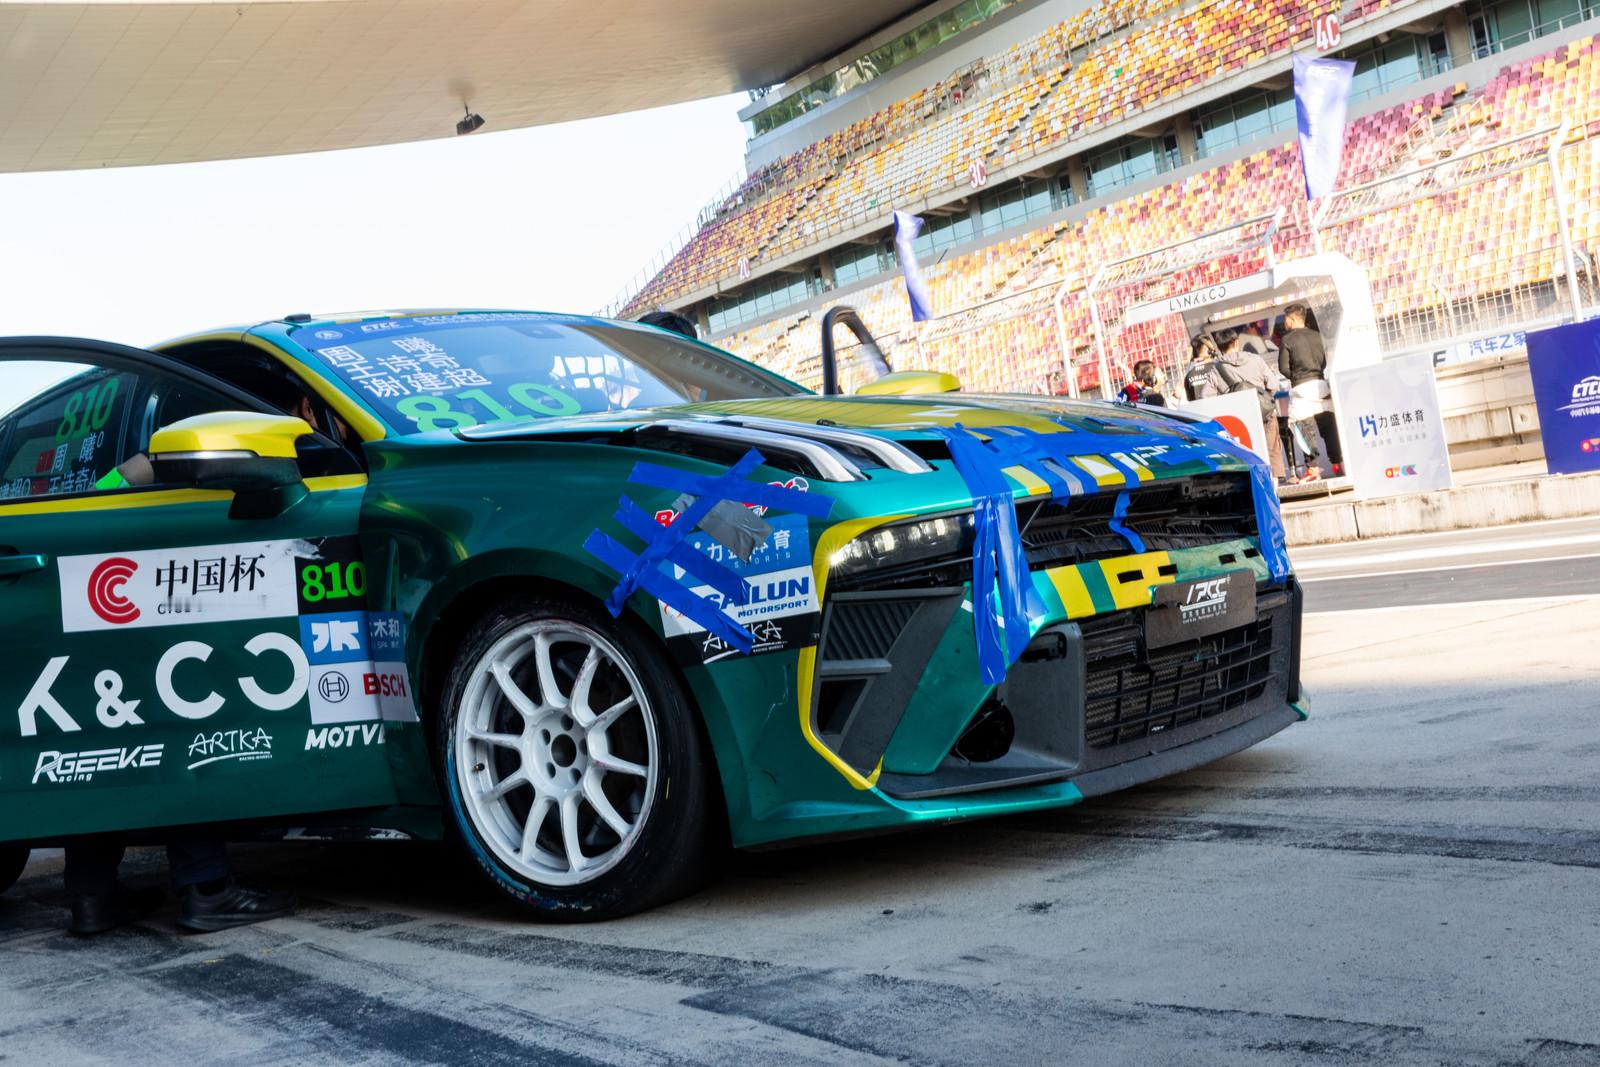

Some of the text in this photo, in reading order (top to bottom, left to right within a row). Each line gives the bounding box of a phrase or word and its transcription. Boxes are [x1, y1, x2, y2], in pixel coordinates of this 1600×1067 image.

[1315, 13, 1341, 50] 4C
[968, 159, 987, 188] 3C
[1468, 331, 1527, 356] 汽车之家
[360, 368, 492, 398] 谢建超
[55, 378, 119, 444] 810
[396, 382, 581, 433] 810
[1378, 409, 1424, 428] 力盛体育
[707, 529, 791, 562] 力育
[734, 552, 791, 569] SORTS
[155, 553, 266, 597] 中国杯
[302, 561, 366, 602] 810
[738, 599, 809, 618] MOTORSPORT
[702, 620, 782, 653] AKA
[188, 727, 273, 758] ARTKA
